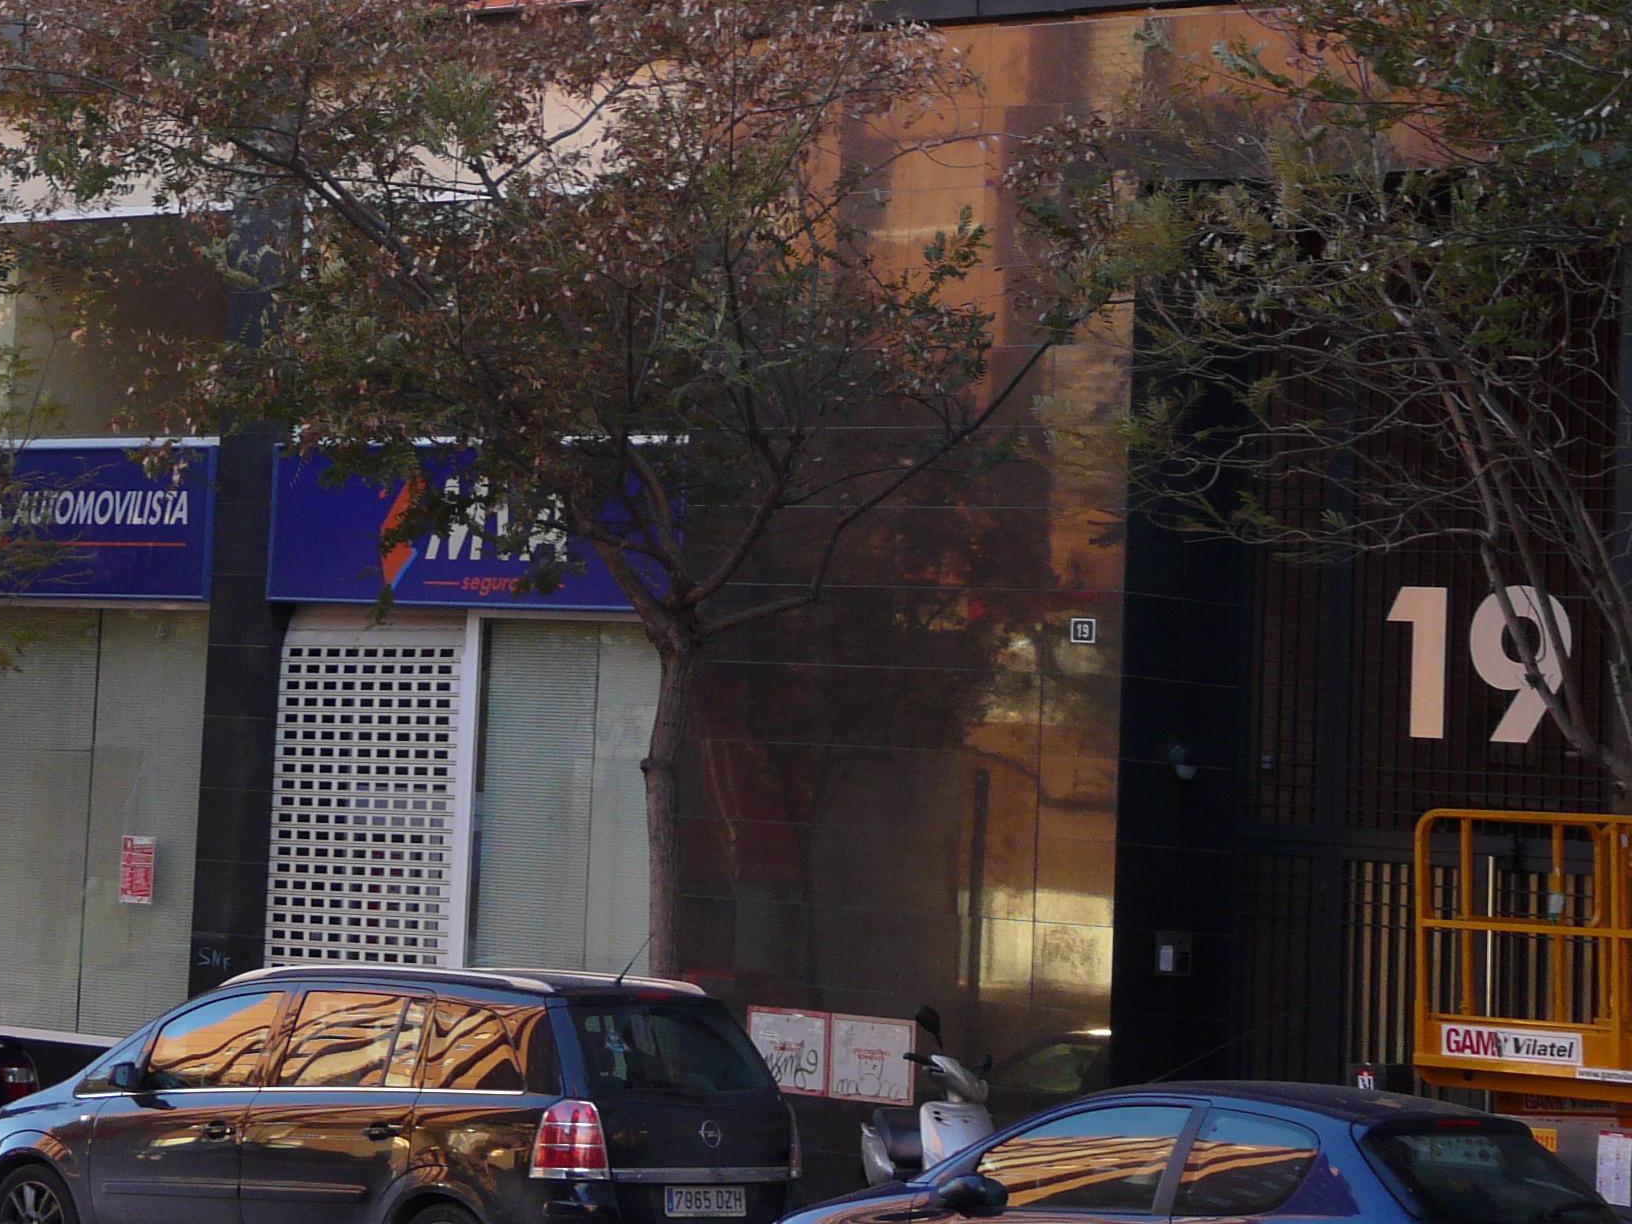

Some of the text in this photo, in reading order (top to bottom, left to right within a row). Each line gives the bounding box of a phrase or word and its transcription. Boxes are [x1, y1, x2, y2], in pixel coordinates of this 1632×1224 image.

[12, 490, 188, 525] AUTOMOVILISTA
[461, 576, 534, 596] seguro
[1077, 623, 1089, 638] 19
[1386, 584, 1572, 743] 19
[1513, 1036, 1574, 1059] Vilatel
[675, 1189, 711, 1210] 7965
